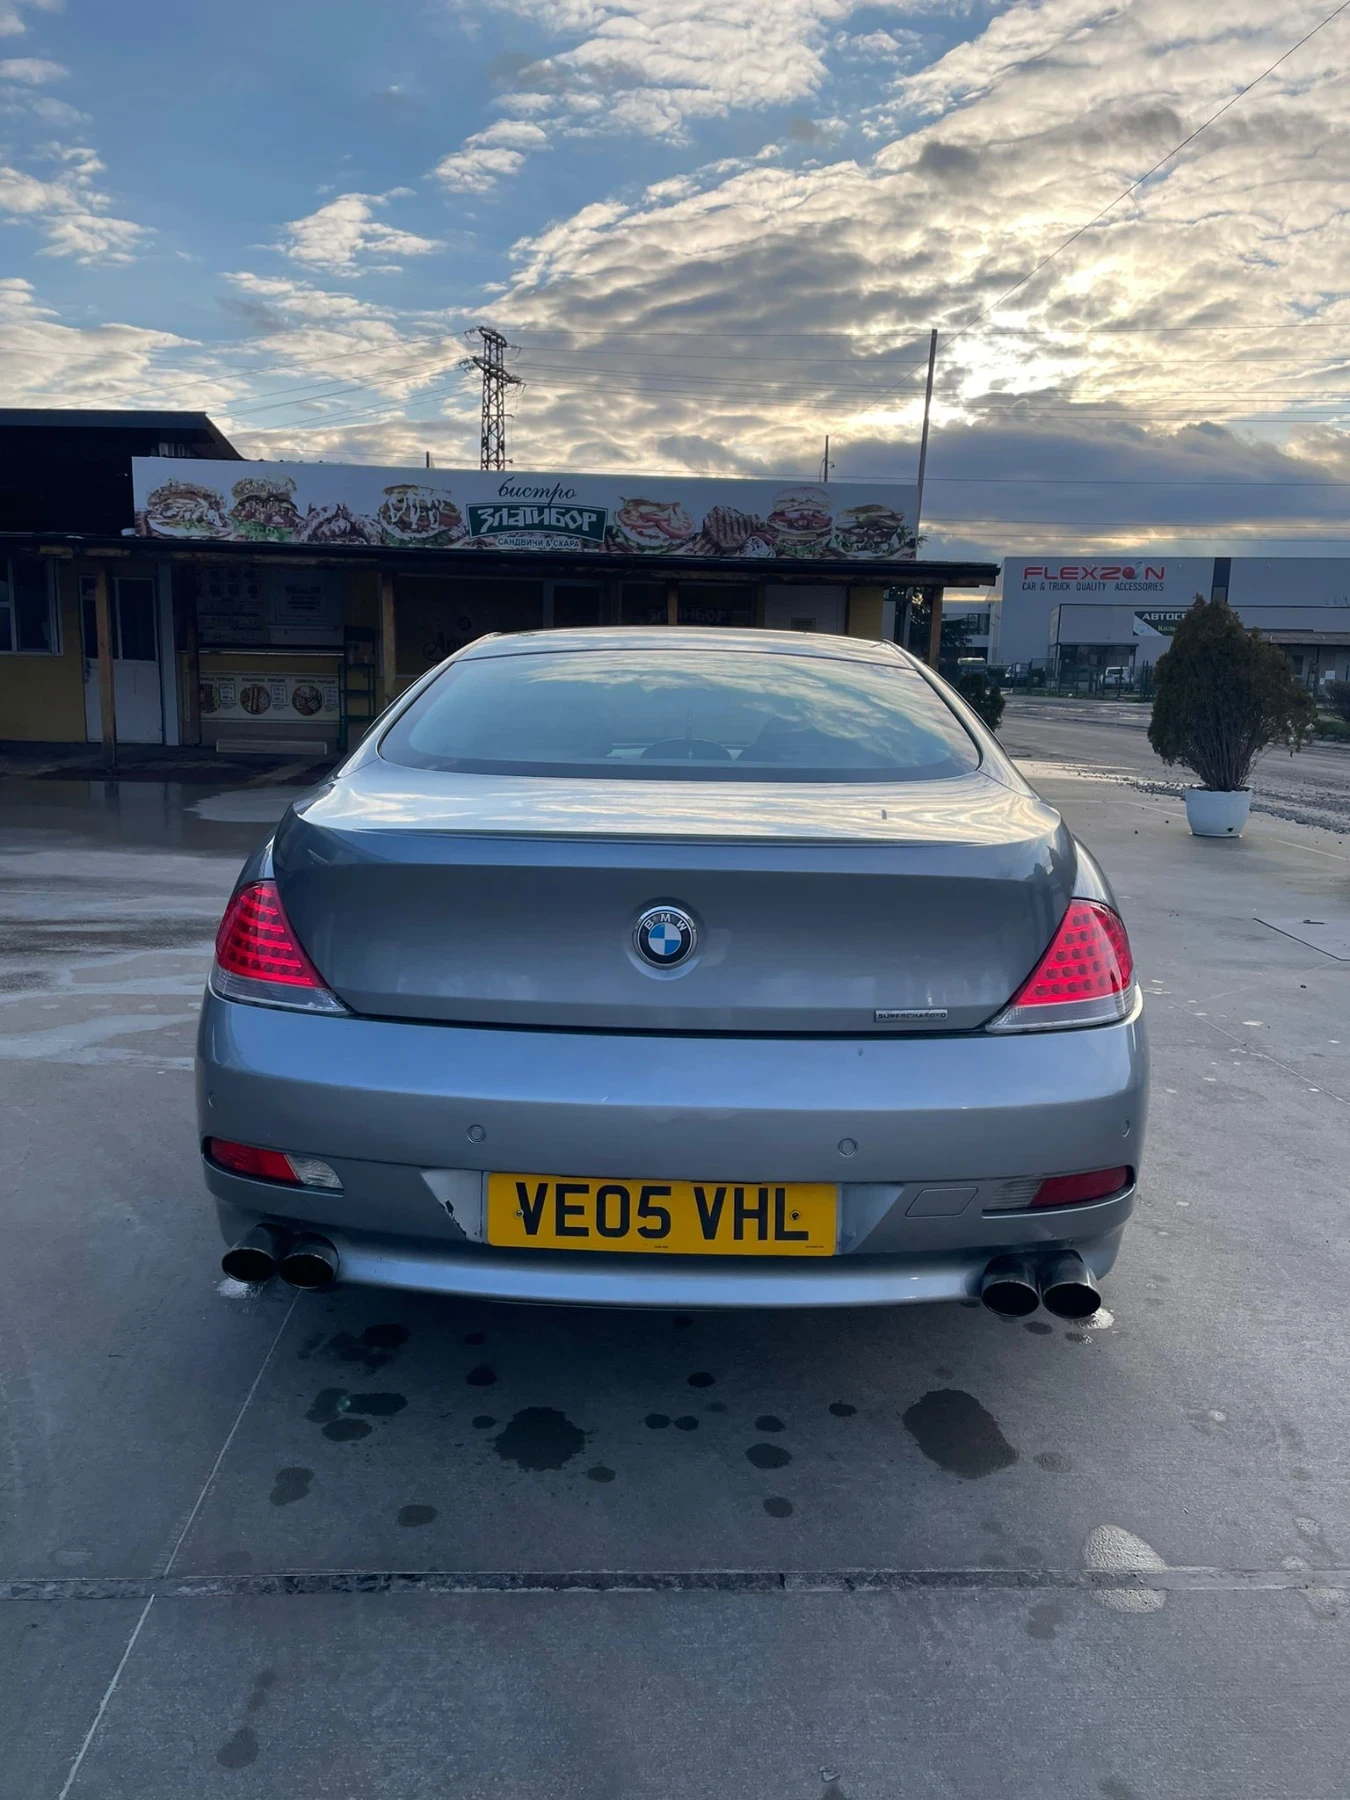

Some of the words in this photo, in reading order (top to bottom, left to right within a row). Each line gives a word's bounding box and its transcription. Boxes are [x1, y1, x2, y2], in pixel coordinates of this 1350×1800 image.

[498, 476, 577, 506] бистро
[477, 507, 597, 533] ЗЛАТИБОР
[498, 538, 543, 547] САНДВИЧИ
[546, 539, 551, 547] &
[553, 540, 579, 548] СКАРА
[1023, 565, 1165, 580] FLEXZON
[1022, 582, 1036, 591] CAR
[1040, 582, 1045, 591] &
[1049, 582, 1071, 591] TRUCK
[1076, 582, 1106, 592] QUALITY
[1114, 582, 1164, 592] ACCESSORIES
[644, 913, 688, 931] BMW
[515, 1182, 672, 1239] VE05
[693, 1186, 809, 1241] VHL
